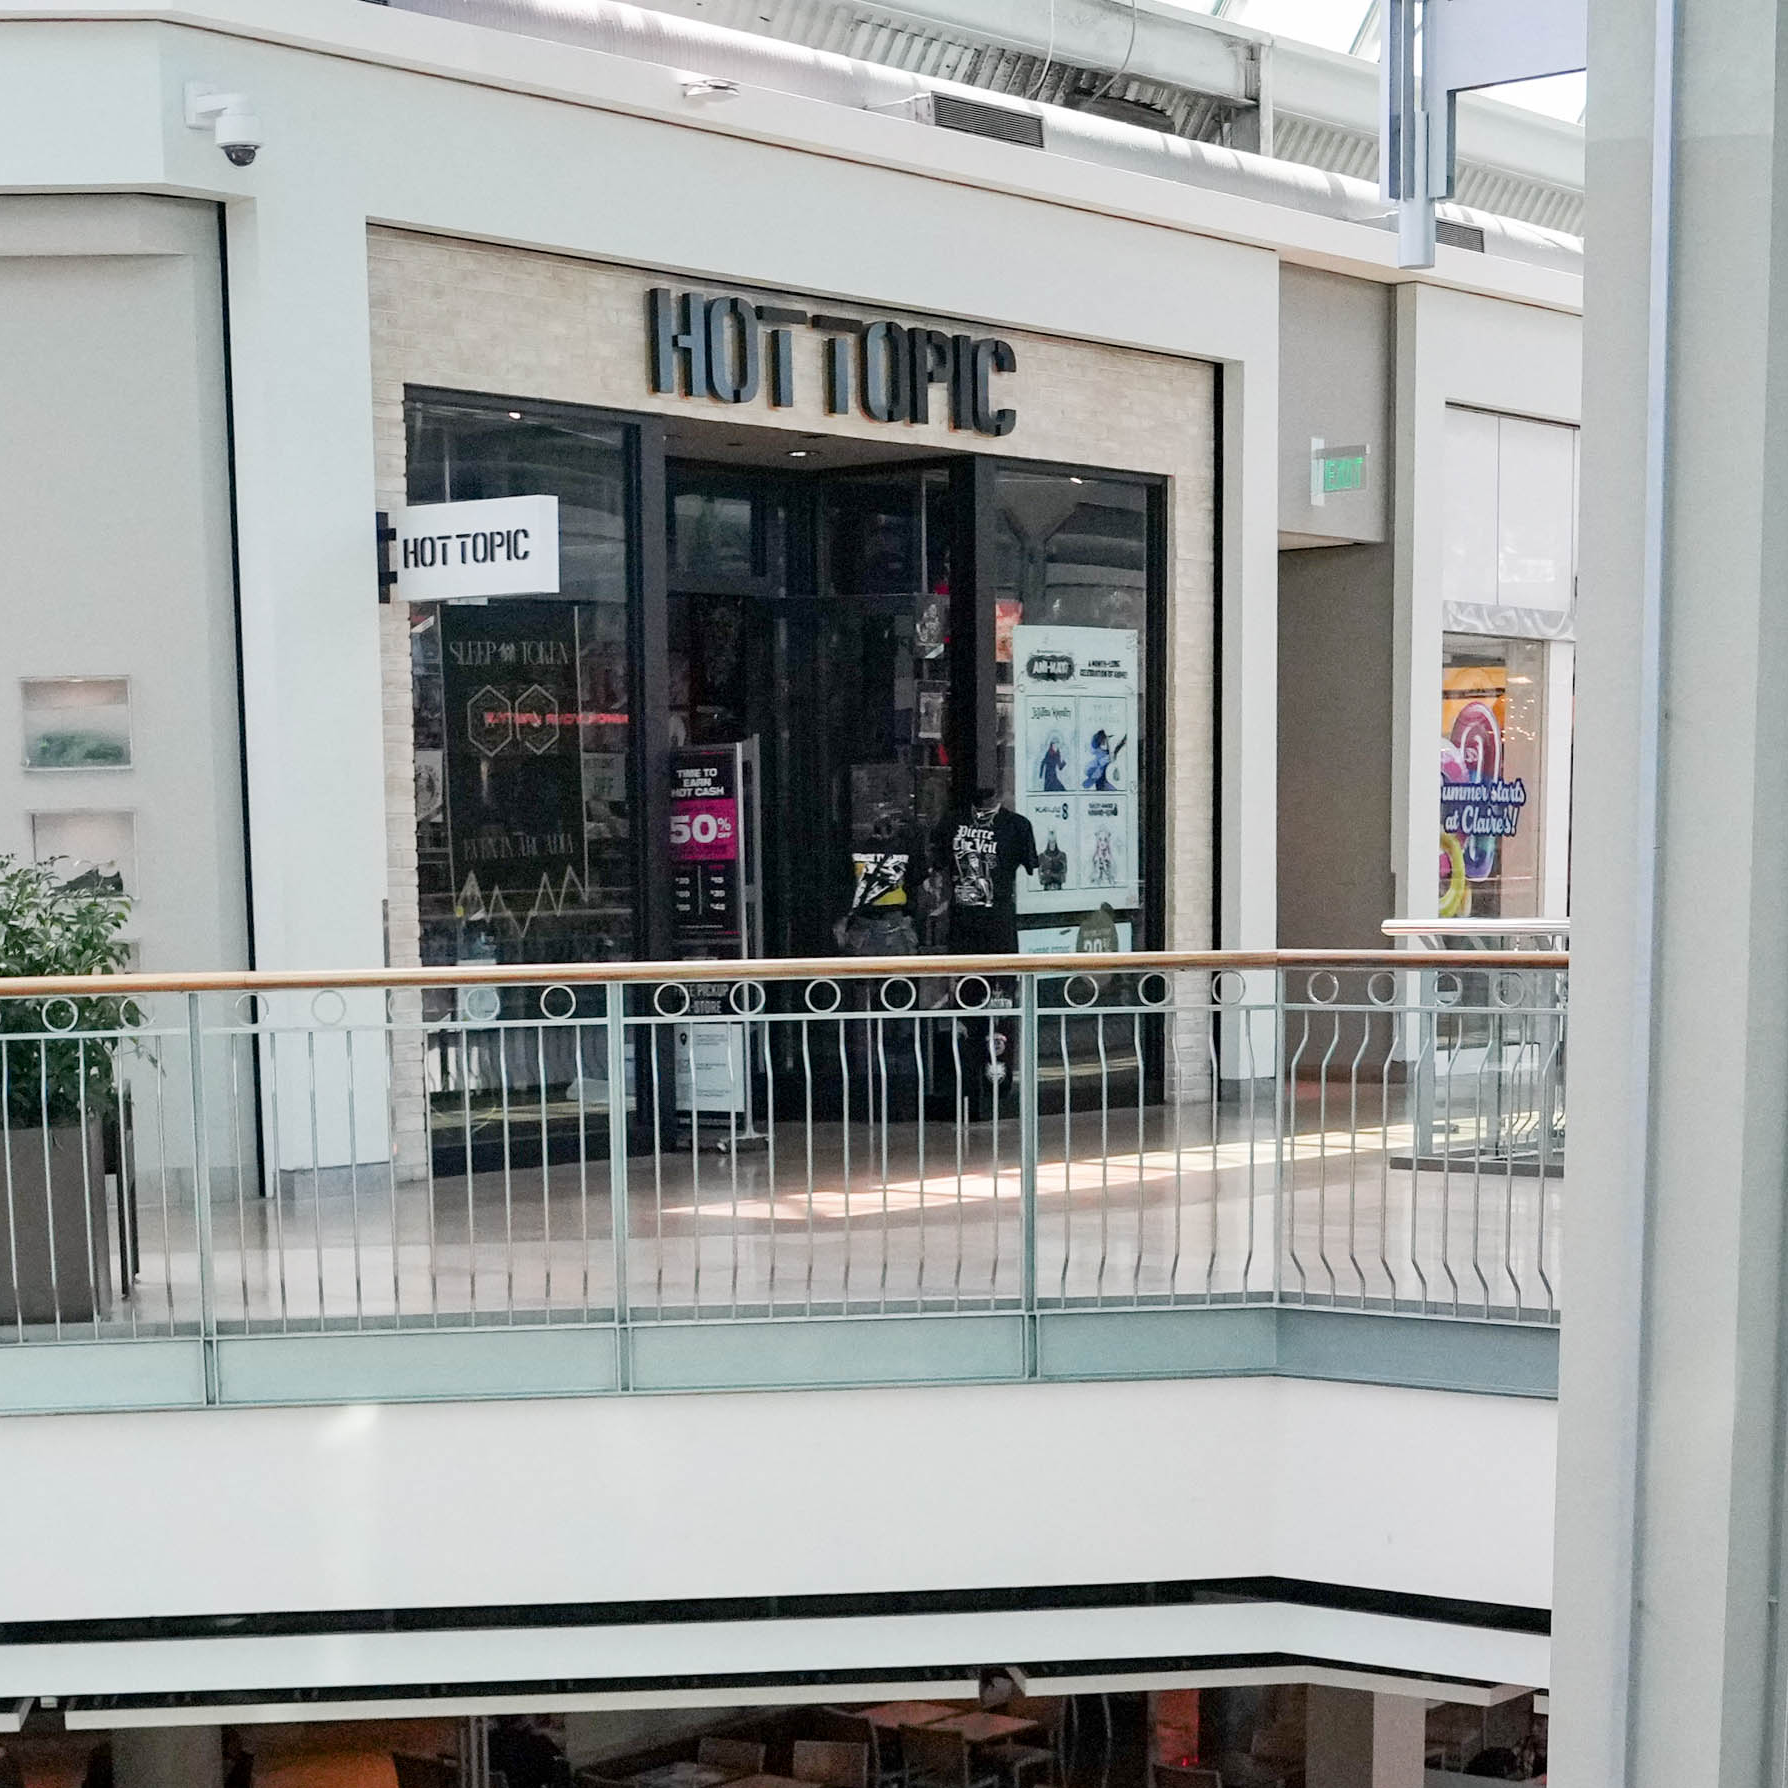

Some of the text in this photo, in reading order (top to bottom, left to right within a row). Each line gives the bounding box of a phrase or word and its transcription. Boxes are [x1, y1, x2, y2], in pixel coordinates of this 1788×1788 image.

[647, 288, 1017, 436] HOT TOPIC
[403, 528, 531, 569] HOT TOPIC
[677, 768, 718, 779] TIME TO
[683, 778, 712, 787] EARN
[671, 787, 725, 798] HOT CASH
[1442, 779, 1526, 803] ummer starts
[669, 814, 732, 843] 50%
[1444, 806, 1519, 835] at Claire's!
[956, 824, 995, 841] Pierce
[953, 837, 998, 854] The Veil
